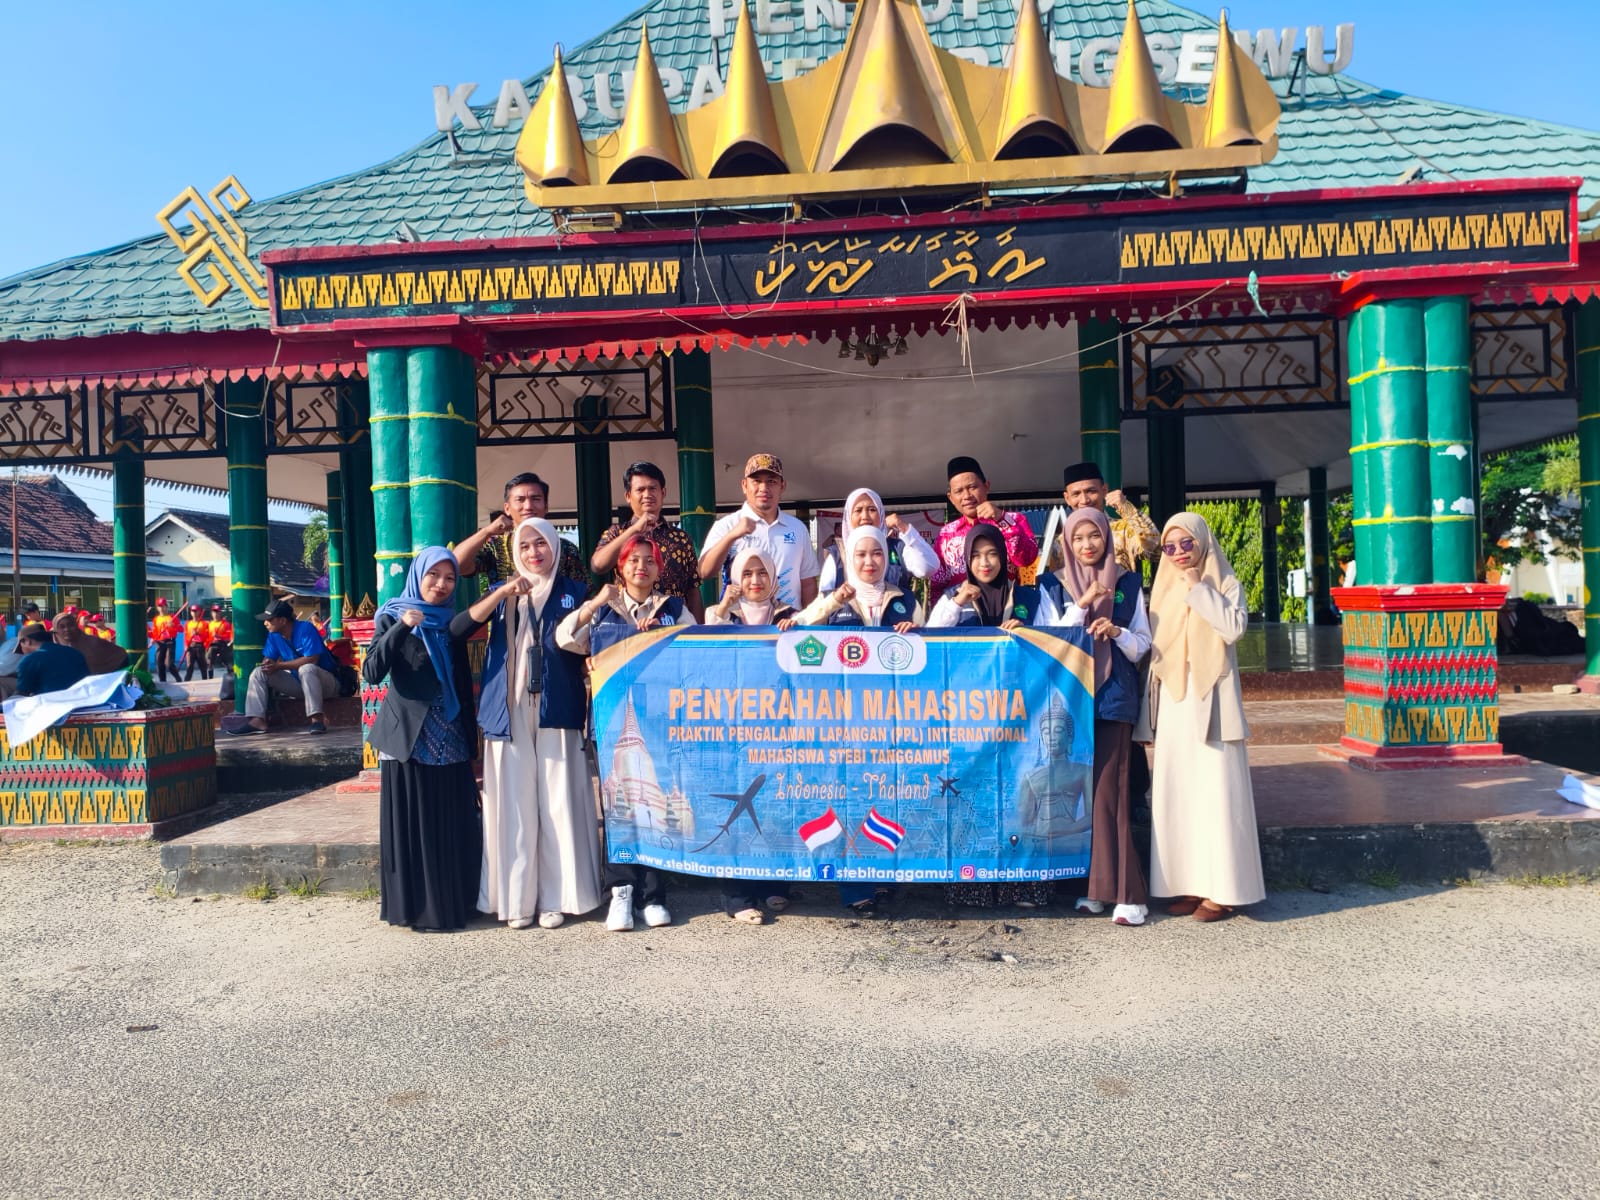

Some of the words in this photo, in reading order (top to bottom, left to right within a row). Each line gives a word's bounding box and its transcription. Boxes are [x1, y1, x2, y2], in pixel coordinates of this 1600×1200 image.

[847, 645, 862, 660] B
[668, 687, 853, 720] PENYERAHAN
[862, 688, 1028, 721] MAHASISWA
[668, 726, 725, 742] PRAKTIK
[728, 726, 815, 742] PENGALAMAN
[819, 726, 887, 742] LAPANGAN
[890, 726, 924, 745] (PPL)
[927, 726, 1028, 742] INTERNATIONAL
[748, 748, 825, 764] MAHASISWA
[829, 748, 866, 764] STEBI
[871, 749, 950, 764] TANGGAMUS
[775, 771, 847, 800] Indonesia
[863, 771, 931, 800] Thailand
[636, 853, 812, 879] www.stebitanggamus.ac.id
[836, 866, 954, 881] stebitanggamus
[976, 864, 1087, 880] @stebitanggamus
